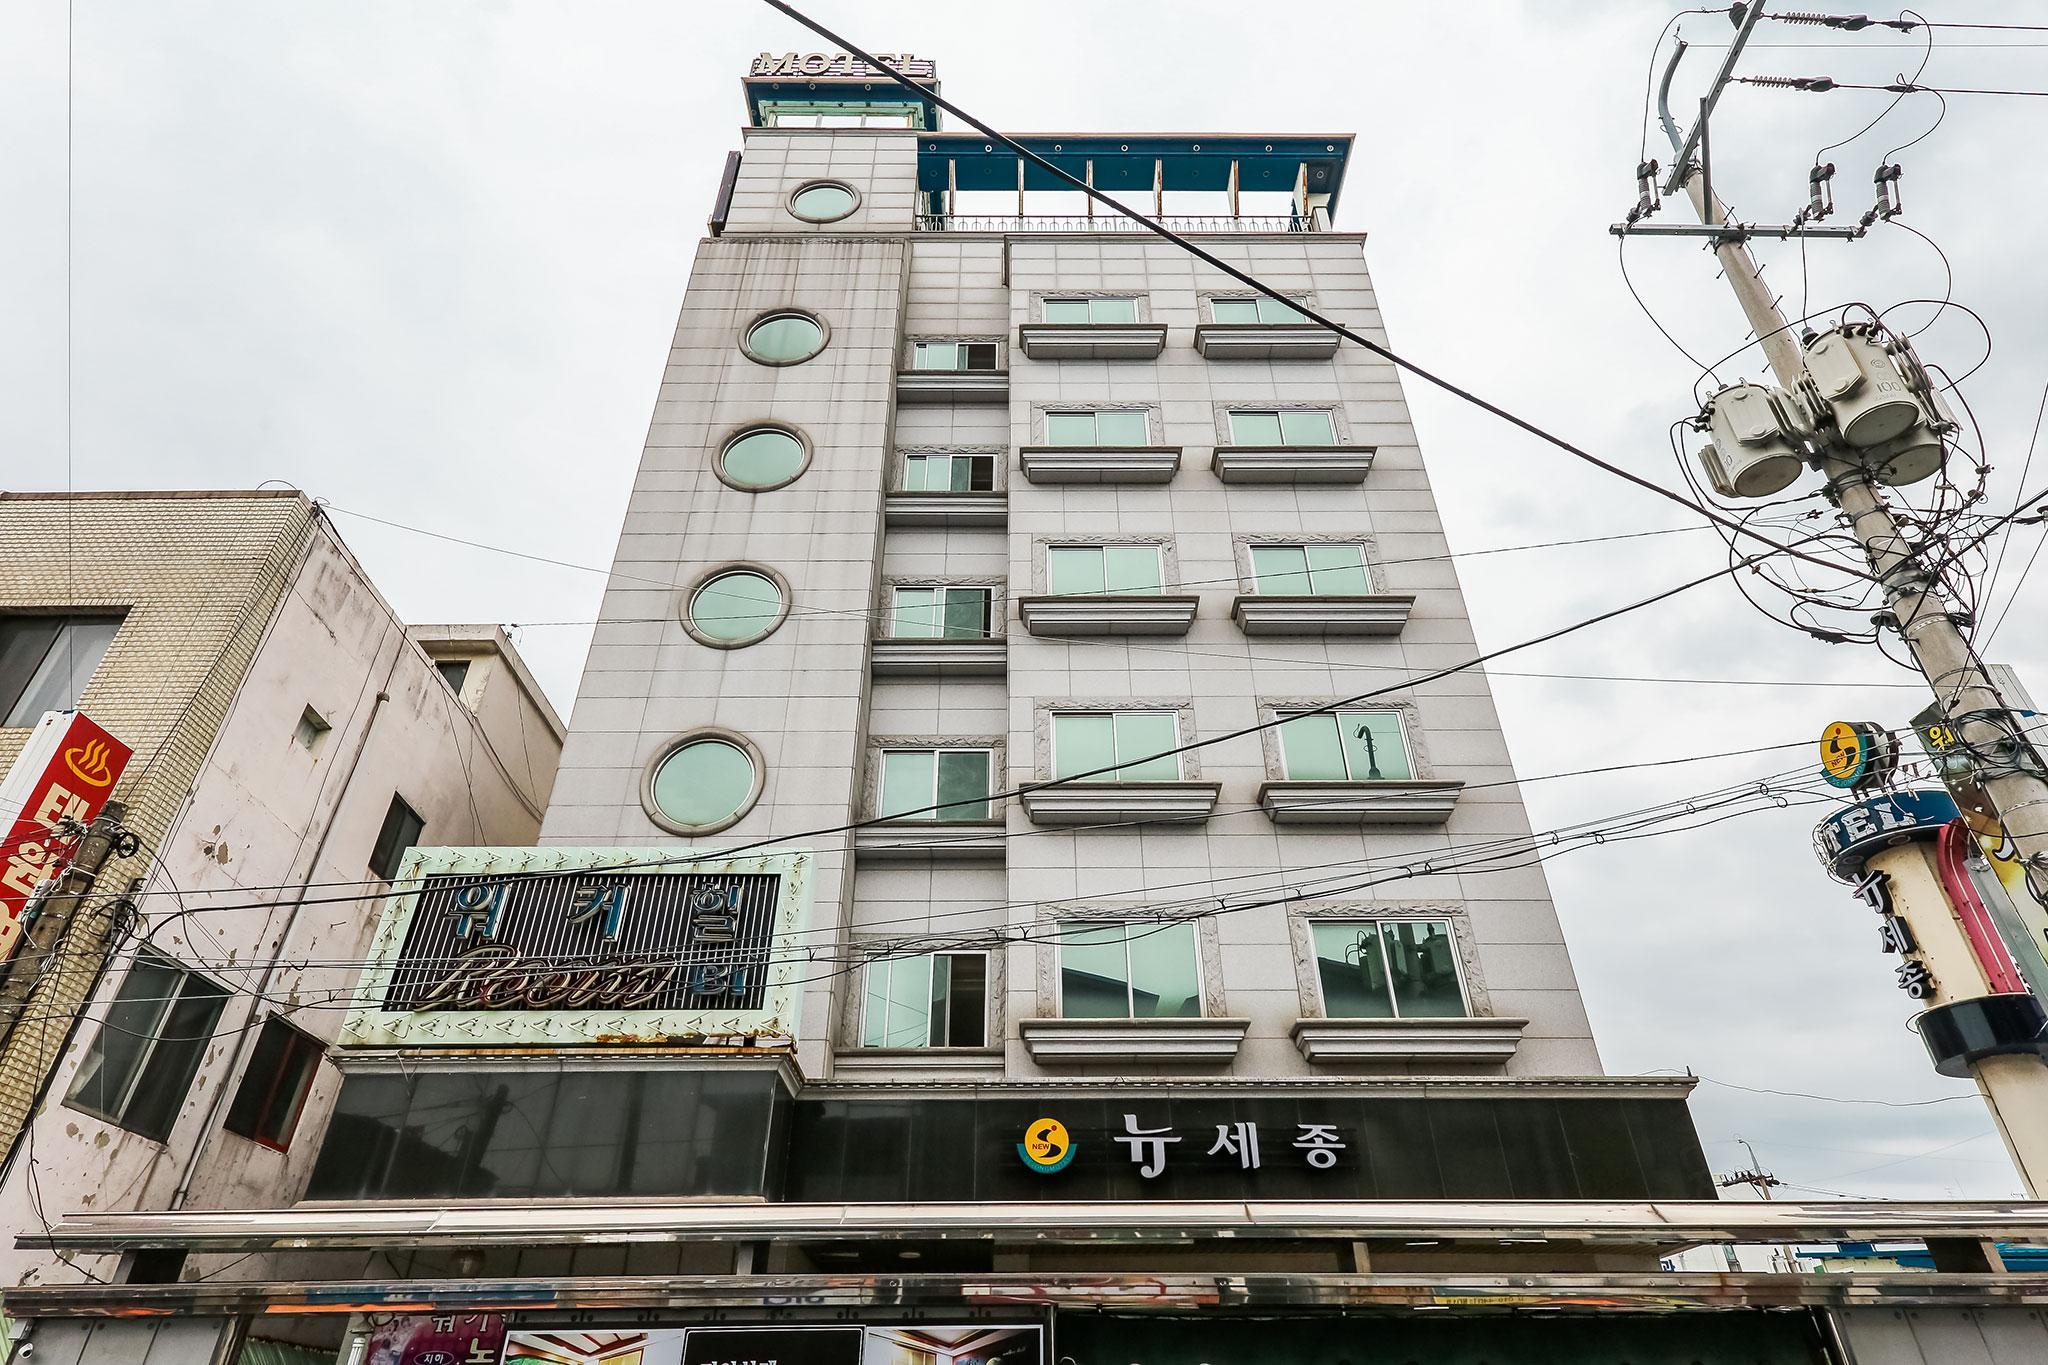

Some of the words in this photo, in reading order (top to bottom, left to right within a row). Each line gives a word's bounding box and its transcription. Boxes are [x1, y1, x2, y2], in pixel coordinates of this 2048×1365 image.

[756, 52, 929, 76] MOTEL
[1852, 870, 1927, 999] 뉴세종
[1113, 1113, 1347, 1179] 뉴세종
